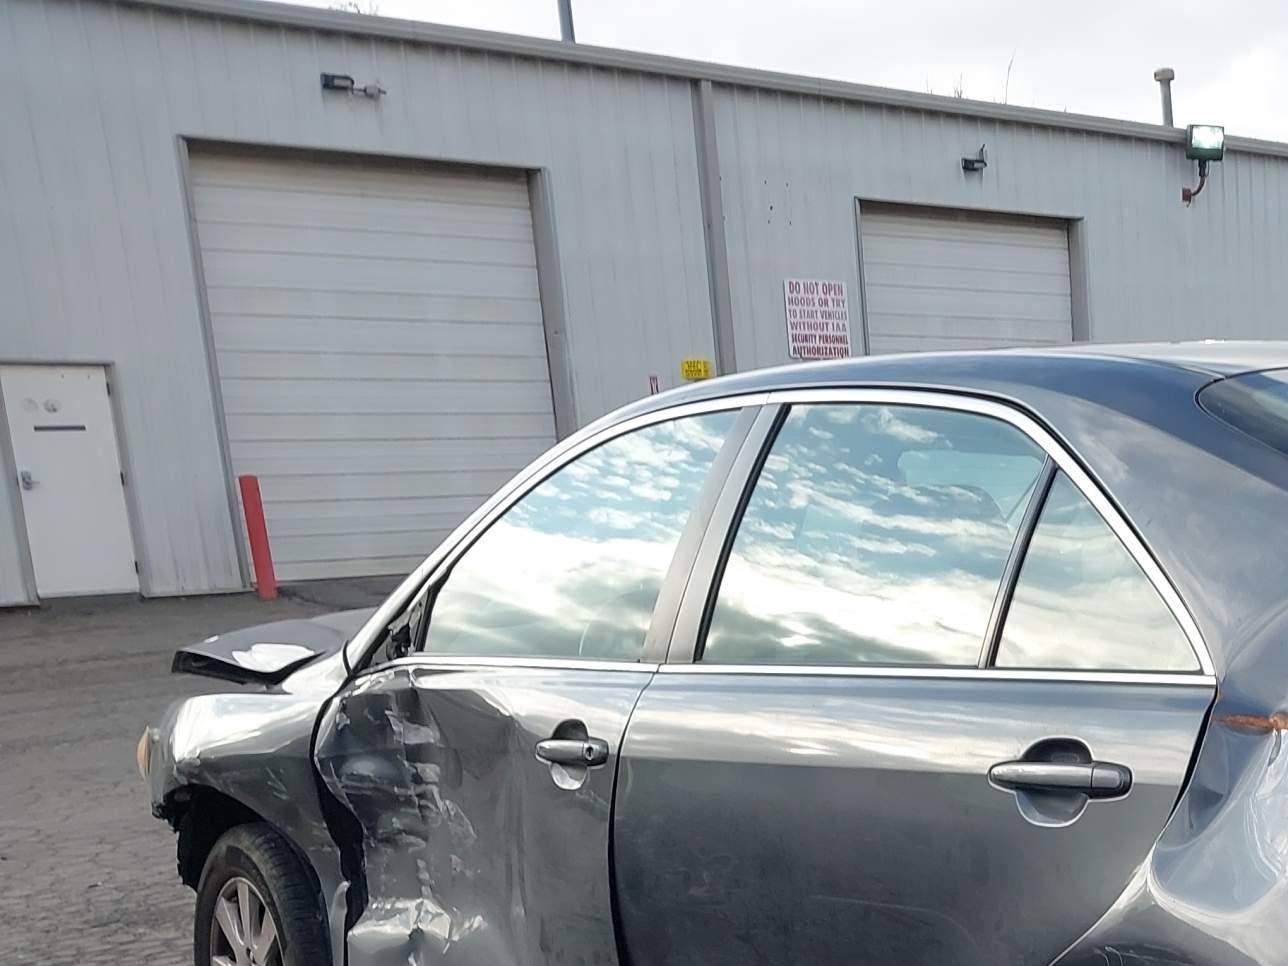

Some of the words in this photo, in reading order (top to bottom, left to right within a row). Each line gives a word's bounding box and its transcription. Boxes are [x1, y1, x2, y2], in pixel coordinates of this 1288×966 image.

[789, 281, 801, 295] DO
[803, 282, 820, 296] NOT
[822, 283, 843, 297] OPEN
[788, 296, 815, 307] HOODS
[818, 298, 829, 308] OR
[832, 298, 846, 309] TRY
[788, 309, 798, 319] TO
[800, 310, 819, 320] START
[820, 310, 848, 321] VEHICLES
[790, 321, 829, 332] WITHOUT
[792, 333, 817, 344] SECURITY
[819, 334, 849, 345] PERSONNEL
[792, 345, 850, 358] AUTHORIZATION
